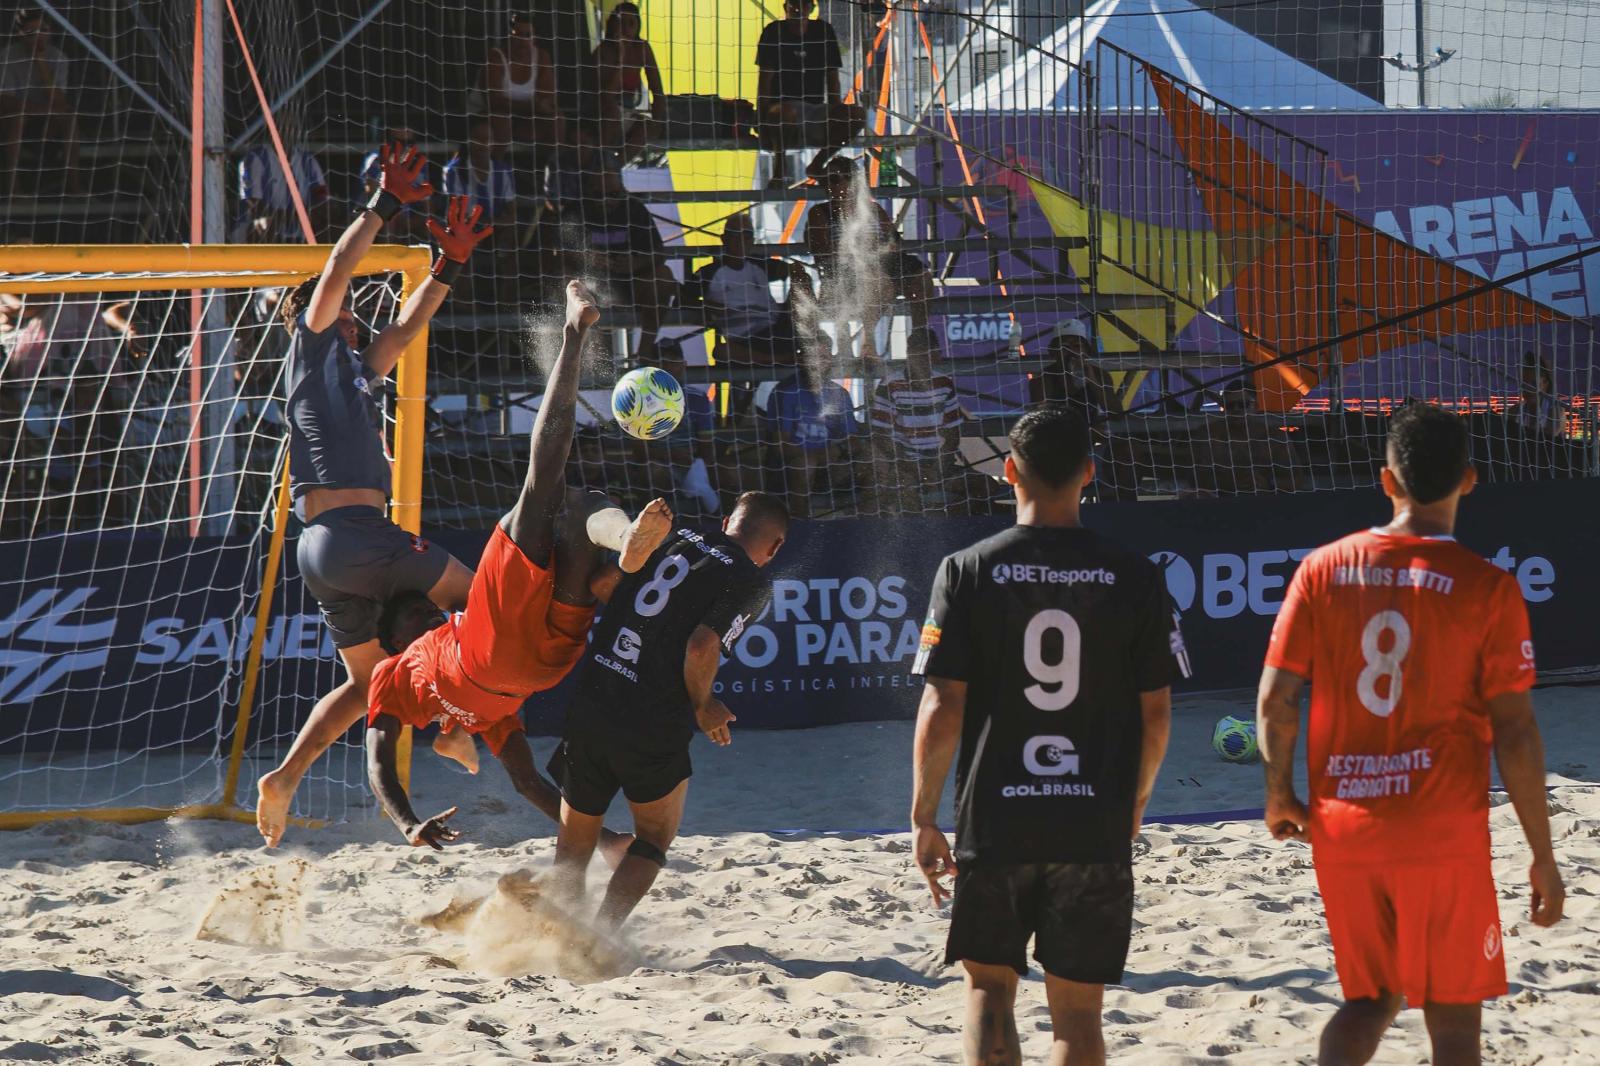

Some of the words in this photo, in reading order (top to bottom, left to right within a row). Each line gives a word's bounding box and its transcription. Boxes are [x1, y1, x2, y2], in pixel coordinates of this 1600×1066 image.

[947, 320, 1013, 340] GAME
[634, 553, 690, 617] 8
[1012, 564, 1116, 586] BETesporte
[1023, 608, 1082, 712] 9
[1357, 611, 1411, 717] 8
